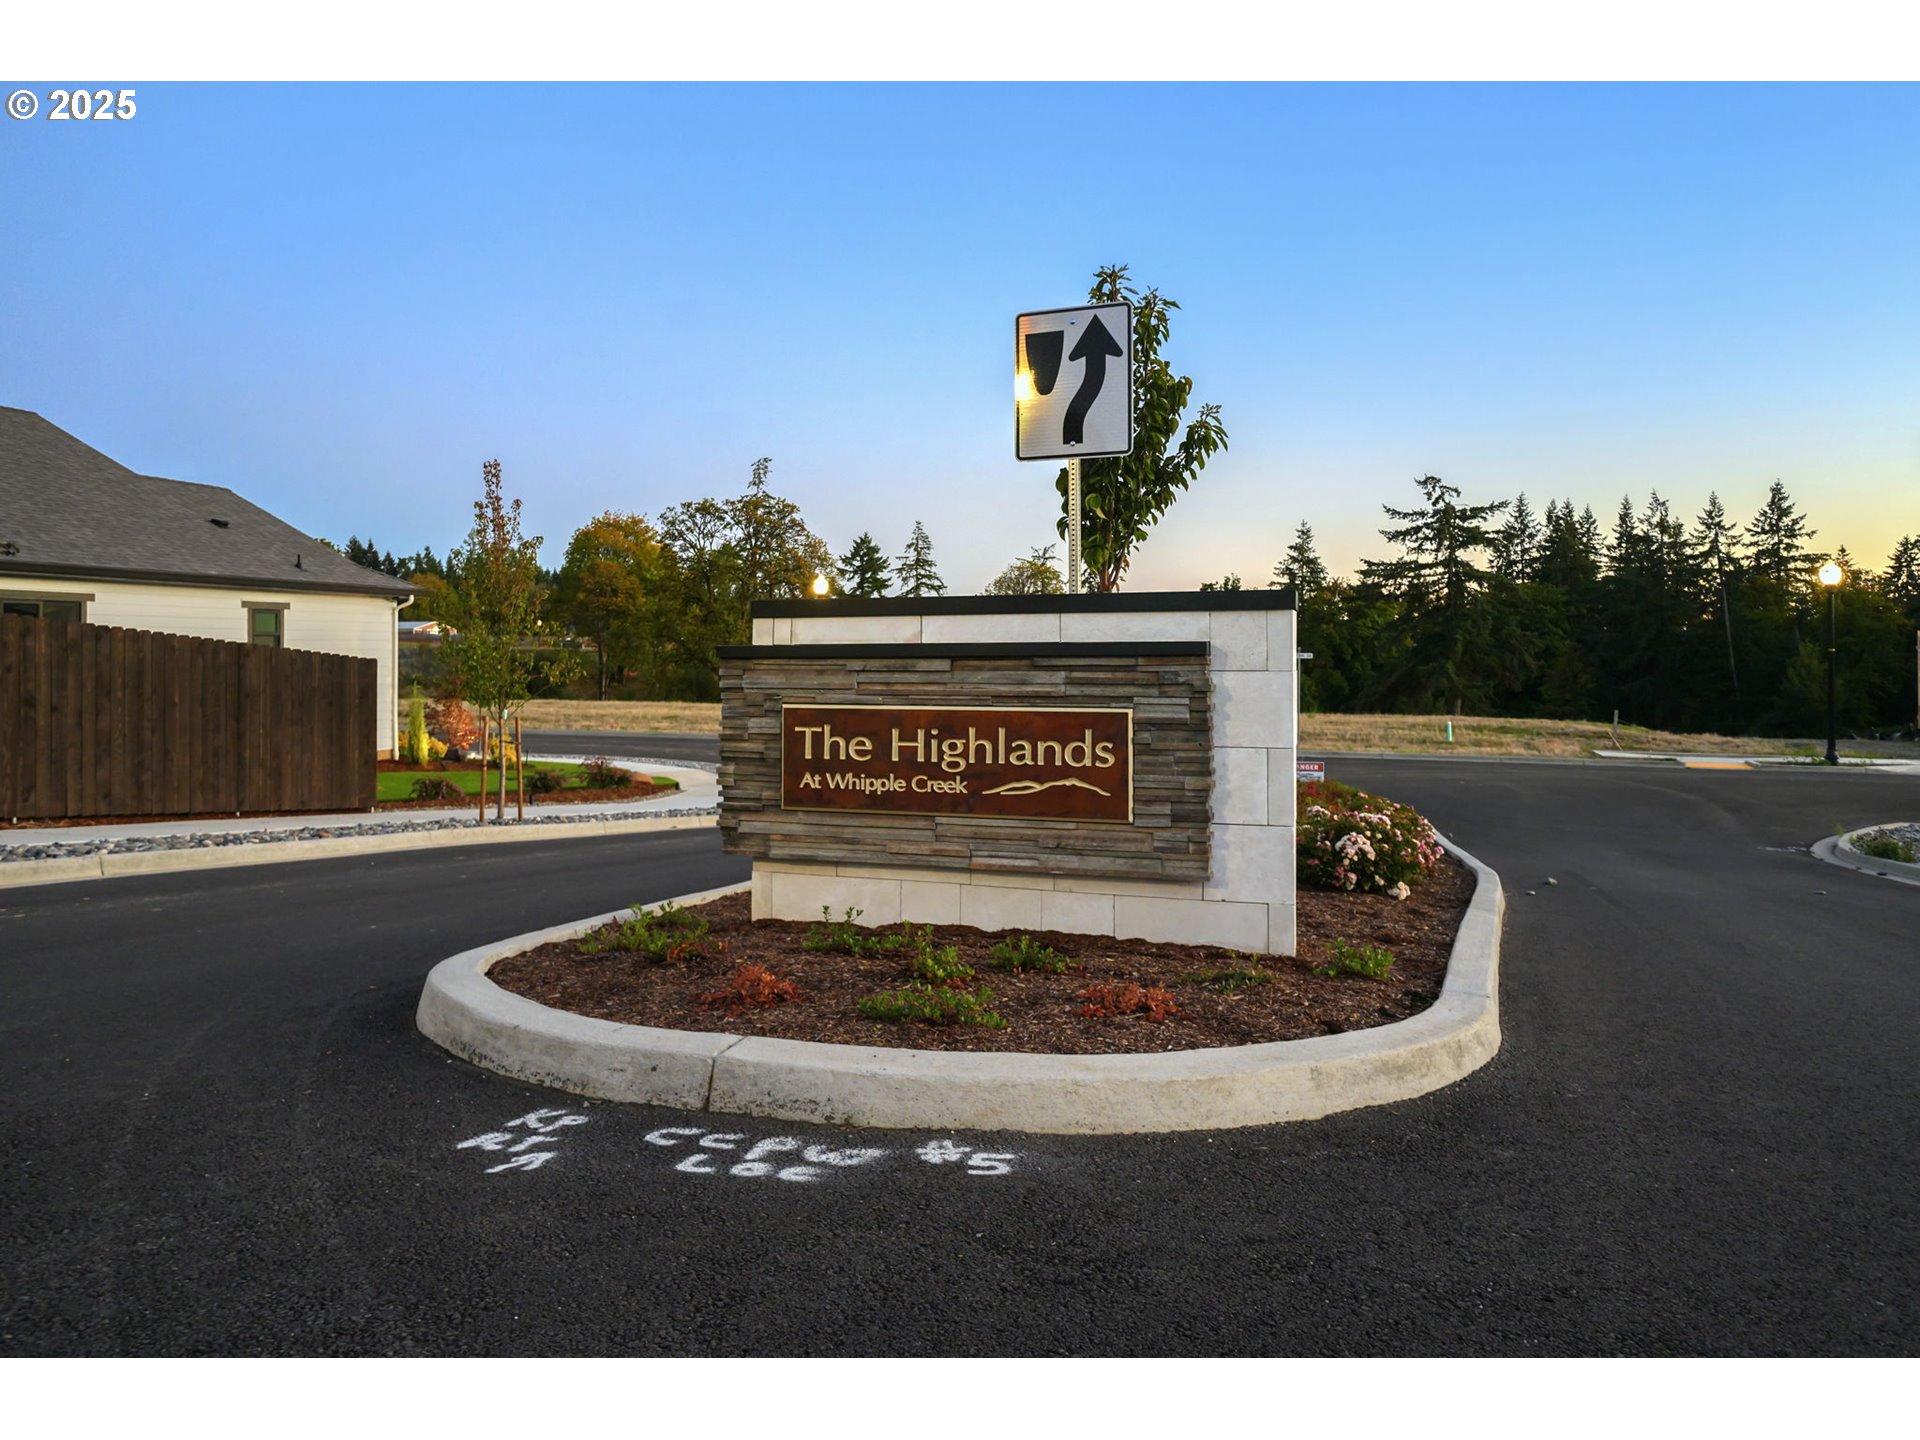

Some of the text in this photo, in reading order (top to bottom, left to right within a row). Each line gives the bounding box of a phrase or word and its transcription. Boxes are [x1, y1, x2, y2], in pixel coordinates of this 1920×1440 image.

[795, 724, 1115, 772] The Highlands
[800, 772, 967, 794] At Whipple Creek
